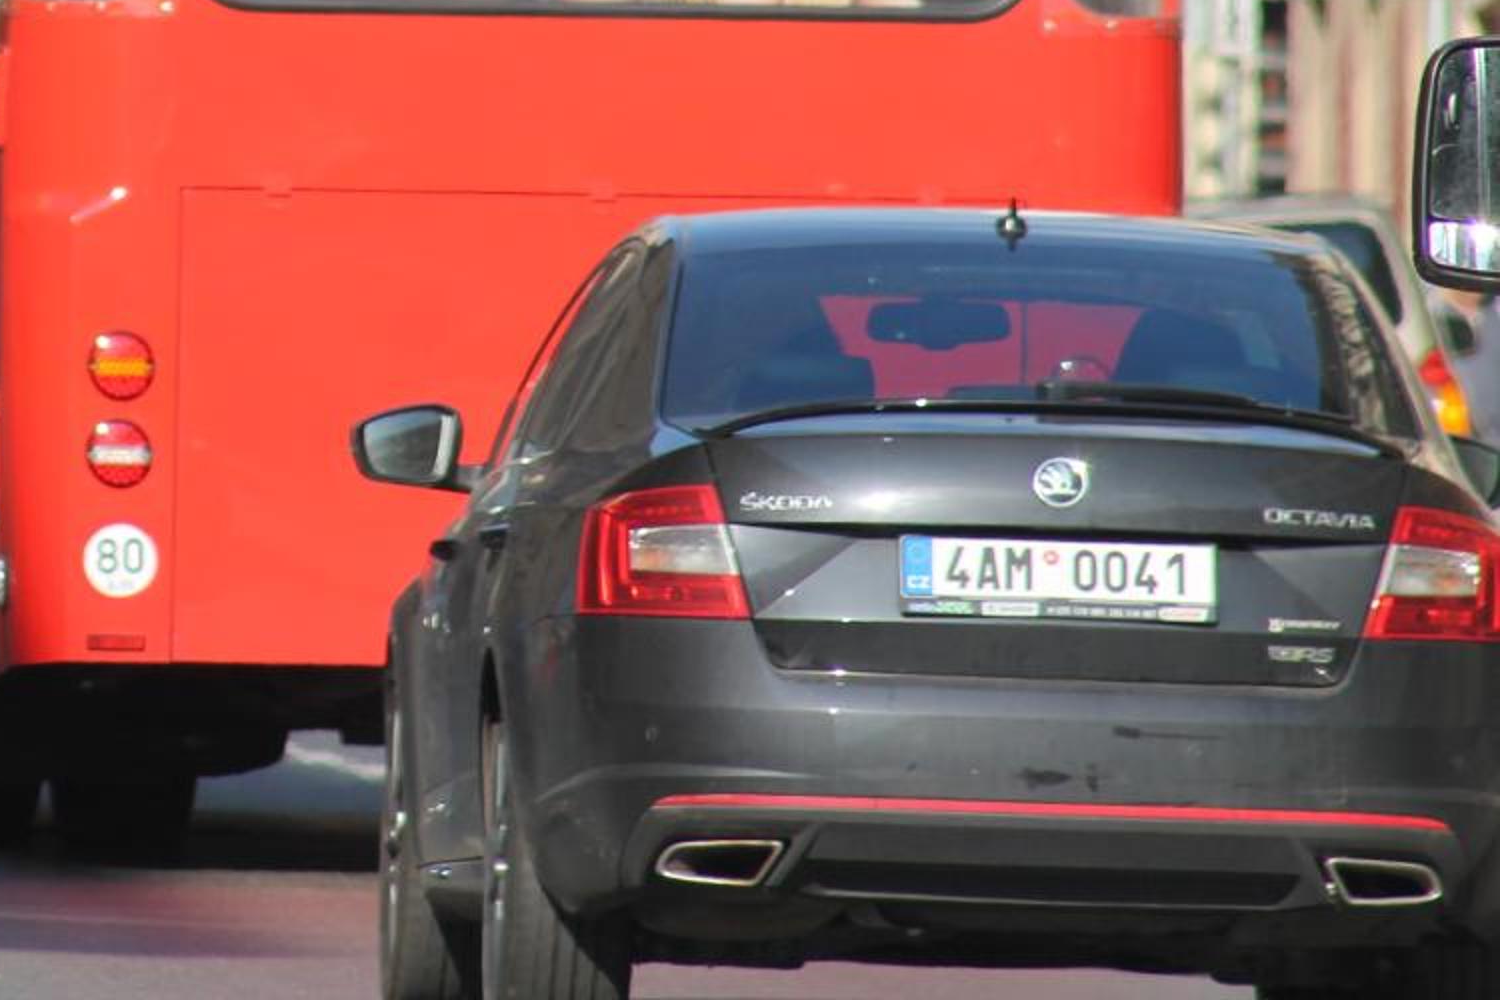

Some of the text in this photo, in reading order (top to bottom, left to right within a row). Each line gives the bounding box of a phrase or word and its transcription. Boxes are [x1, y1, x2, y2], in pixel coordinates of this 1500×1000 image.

[1263, 507, 1376, 530] OCTAVIA
[97, 538, 144, 574] 80
[906, 546, 1186, 595] CZ 4AM 0041
